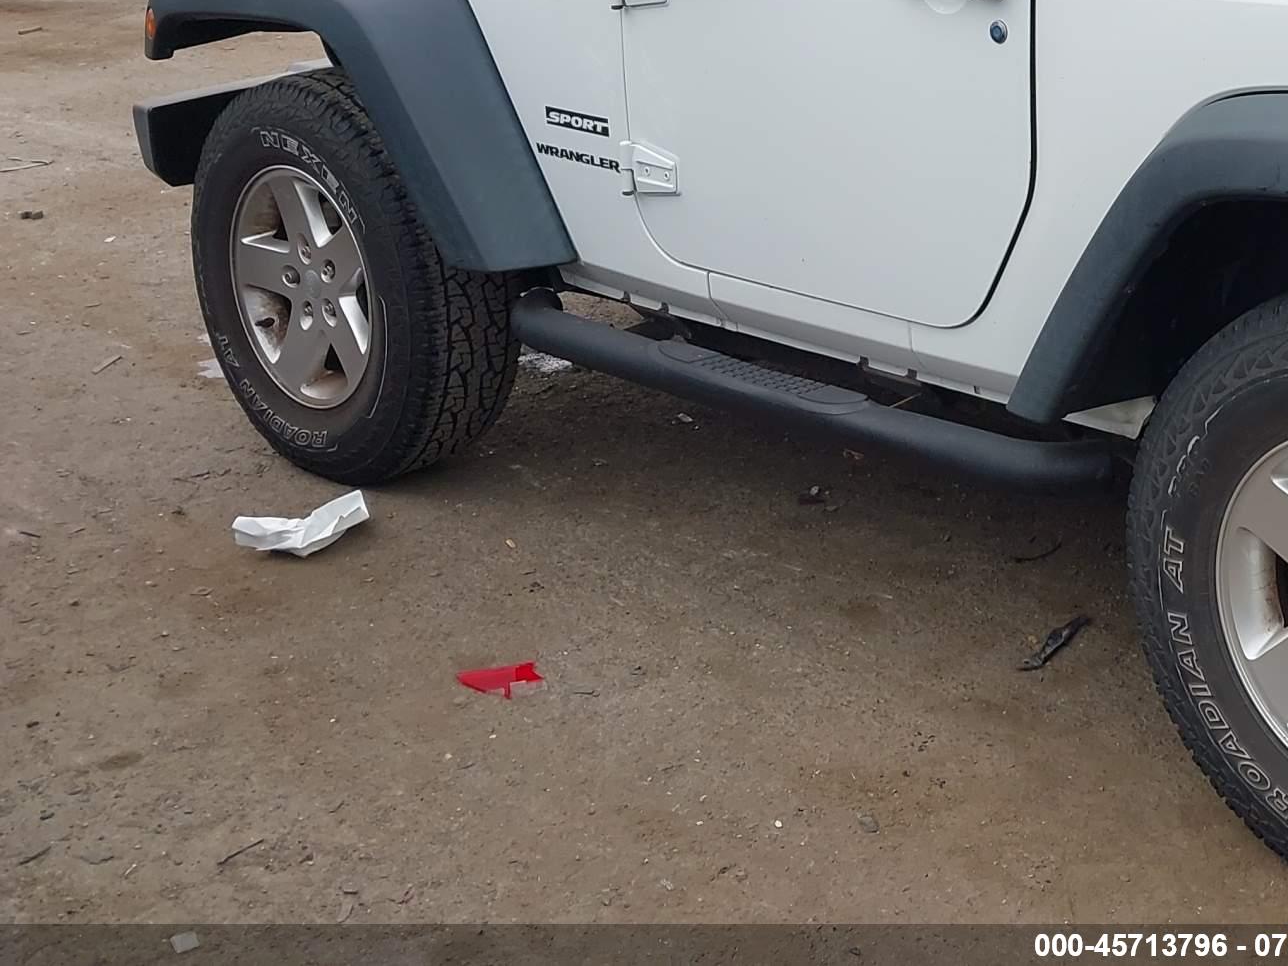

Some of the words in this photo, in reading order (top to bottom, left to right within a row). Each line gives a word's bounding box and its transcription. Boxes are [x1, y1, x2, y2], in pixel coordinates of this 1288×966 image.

[548, 111, 609, 133] SPORT
[259, 130, 359, 226] NEXEN
[536, 141, 622, 174] WRANGLER
[238, 378, 328, 448] ROADIAN
[1163, 525, 1185, 594] AT
